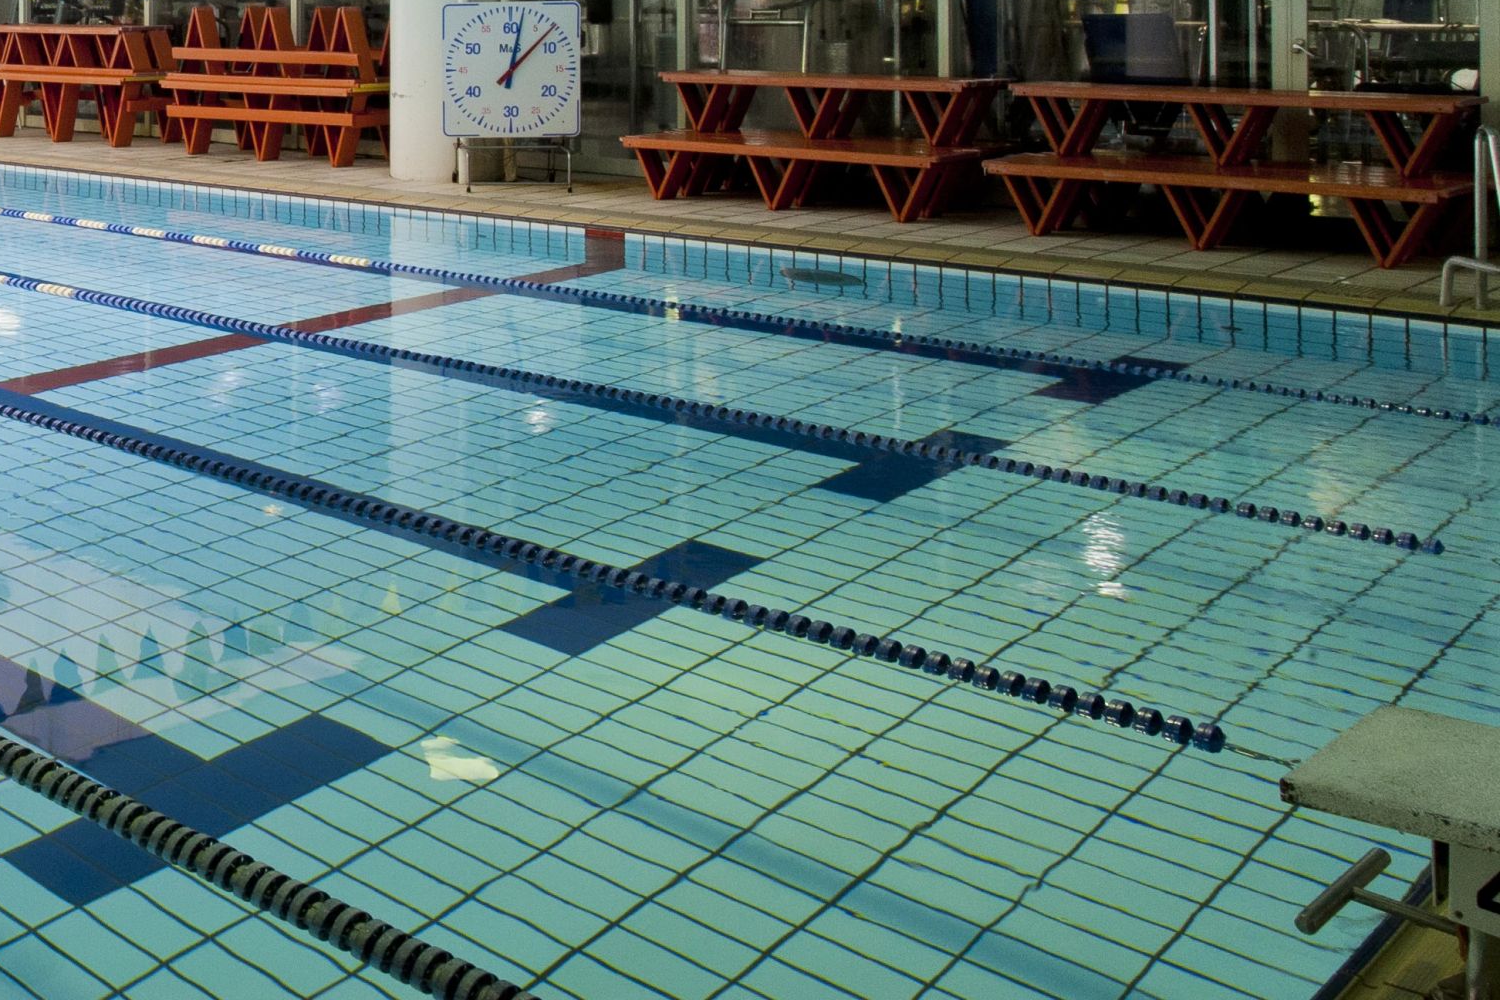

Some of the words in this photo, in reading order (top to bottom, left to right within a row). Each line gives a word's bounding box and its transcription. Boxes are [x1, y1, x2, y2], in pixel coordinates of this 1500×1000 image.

[482, 25, 492, 34] 55
[503, 22, 519, 34] 60
[533, 25, 539, 33] 5
[465, 43, 481, 55] 50
[543, 42, 557, 54] 10
[458, 66, 468, 75] 45
[556, 65, 565, 73] 15
[465, 86, 481, 98] 40
[541, 85, 557, 97] 20
[503, 106, 519, 118] 30
